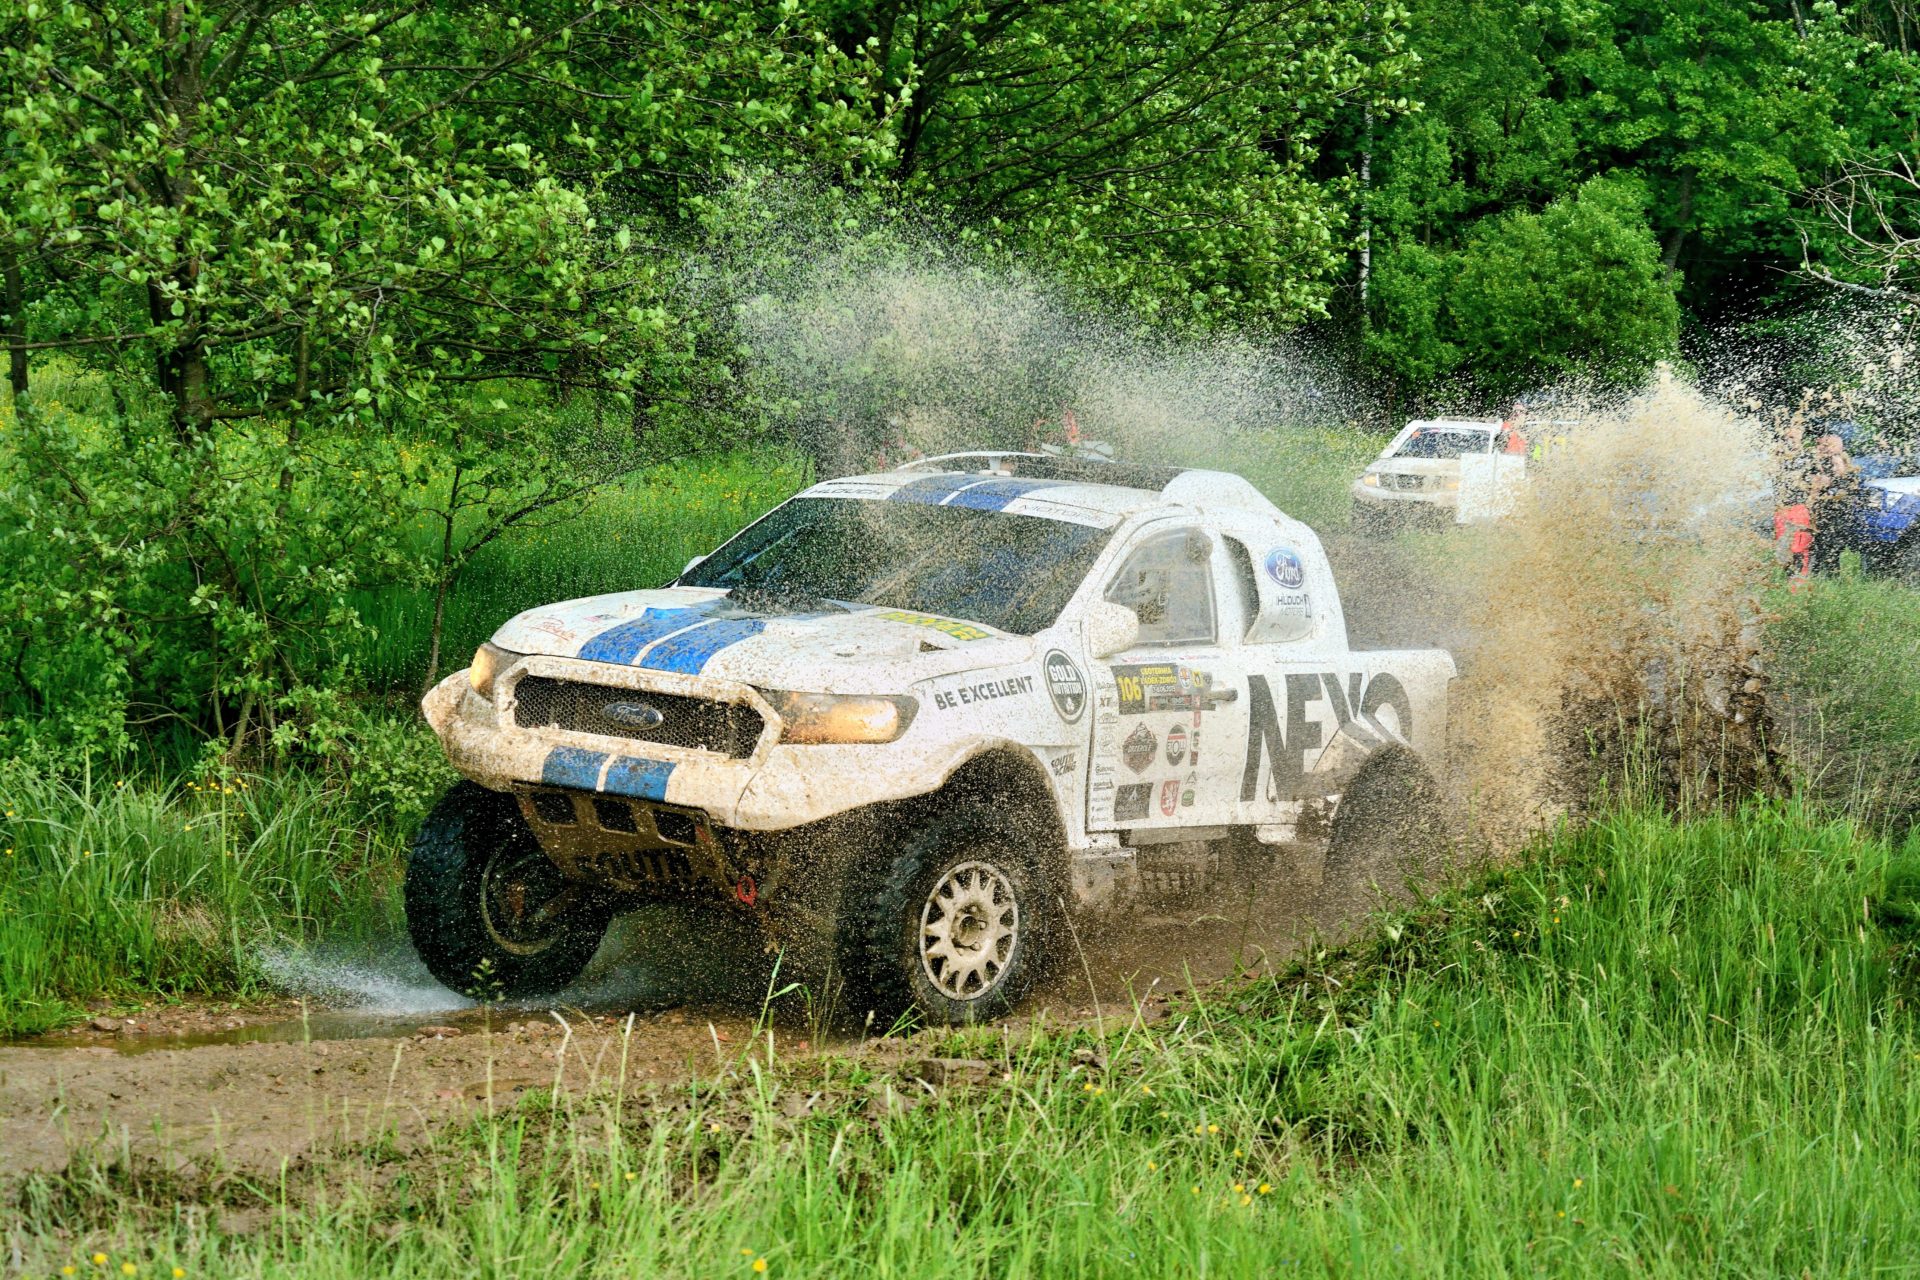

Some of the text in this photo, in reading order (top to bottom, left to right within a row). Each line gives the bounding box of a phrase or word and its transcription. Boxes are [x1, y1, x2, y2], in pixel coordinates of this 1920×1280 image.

[1274, 552, 1303, 583] Ford
[1048, 664, 1077, 682] GOLD
[934, 676, 1034, 710] BE EXCELLENT
[1117, 675, 1142, 702] 106
[1050, 752, 1075, 768] SOUTH
[575, 846, 694, 880] SOUTH
